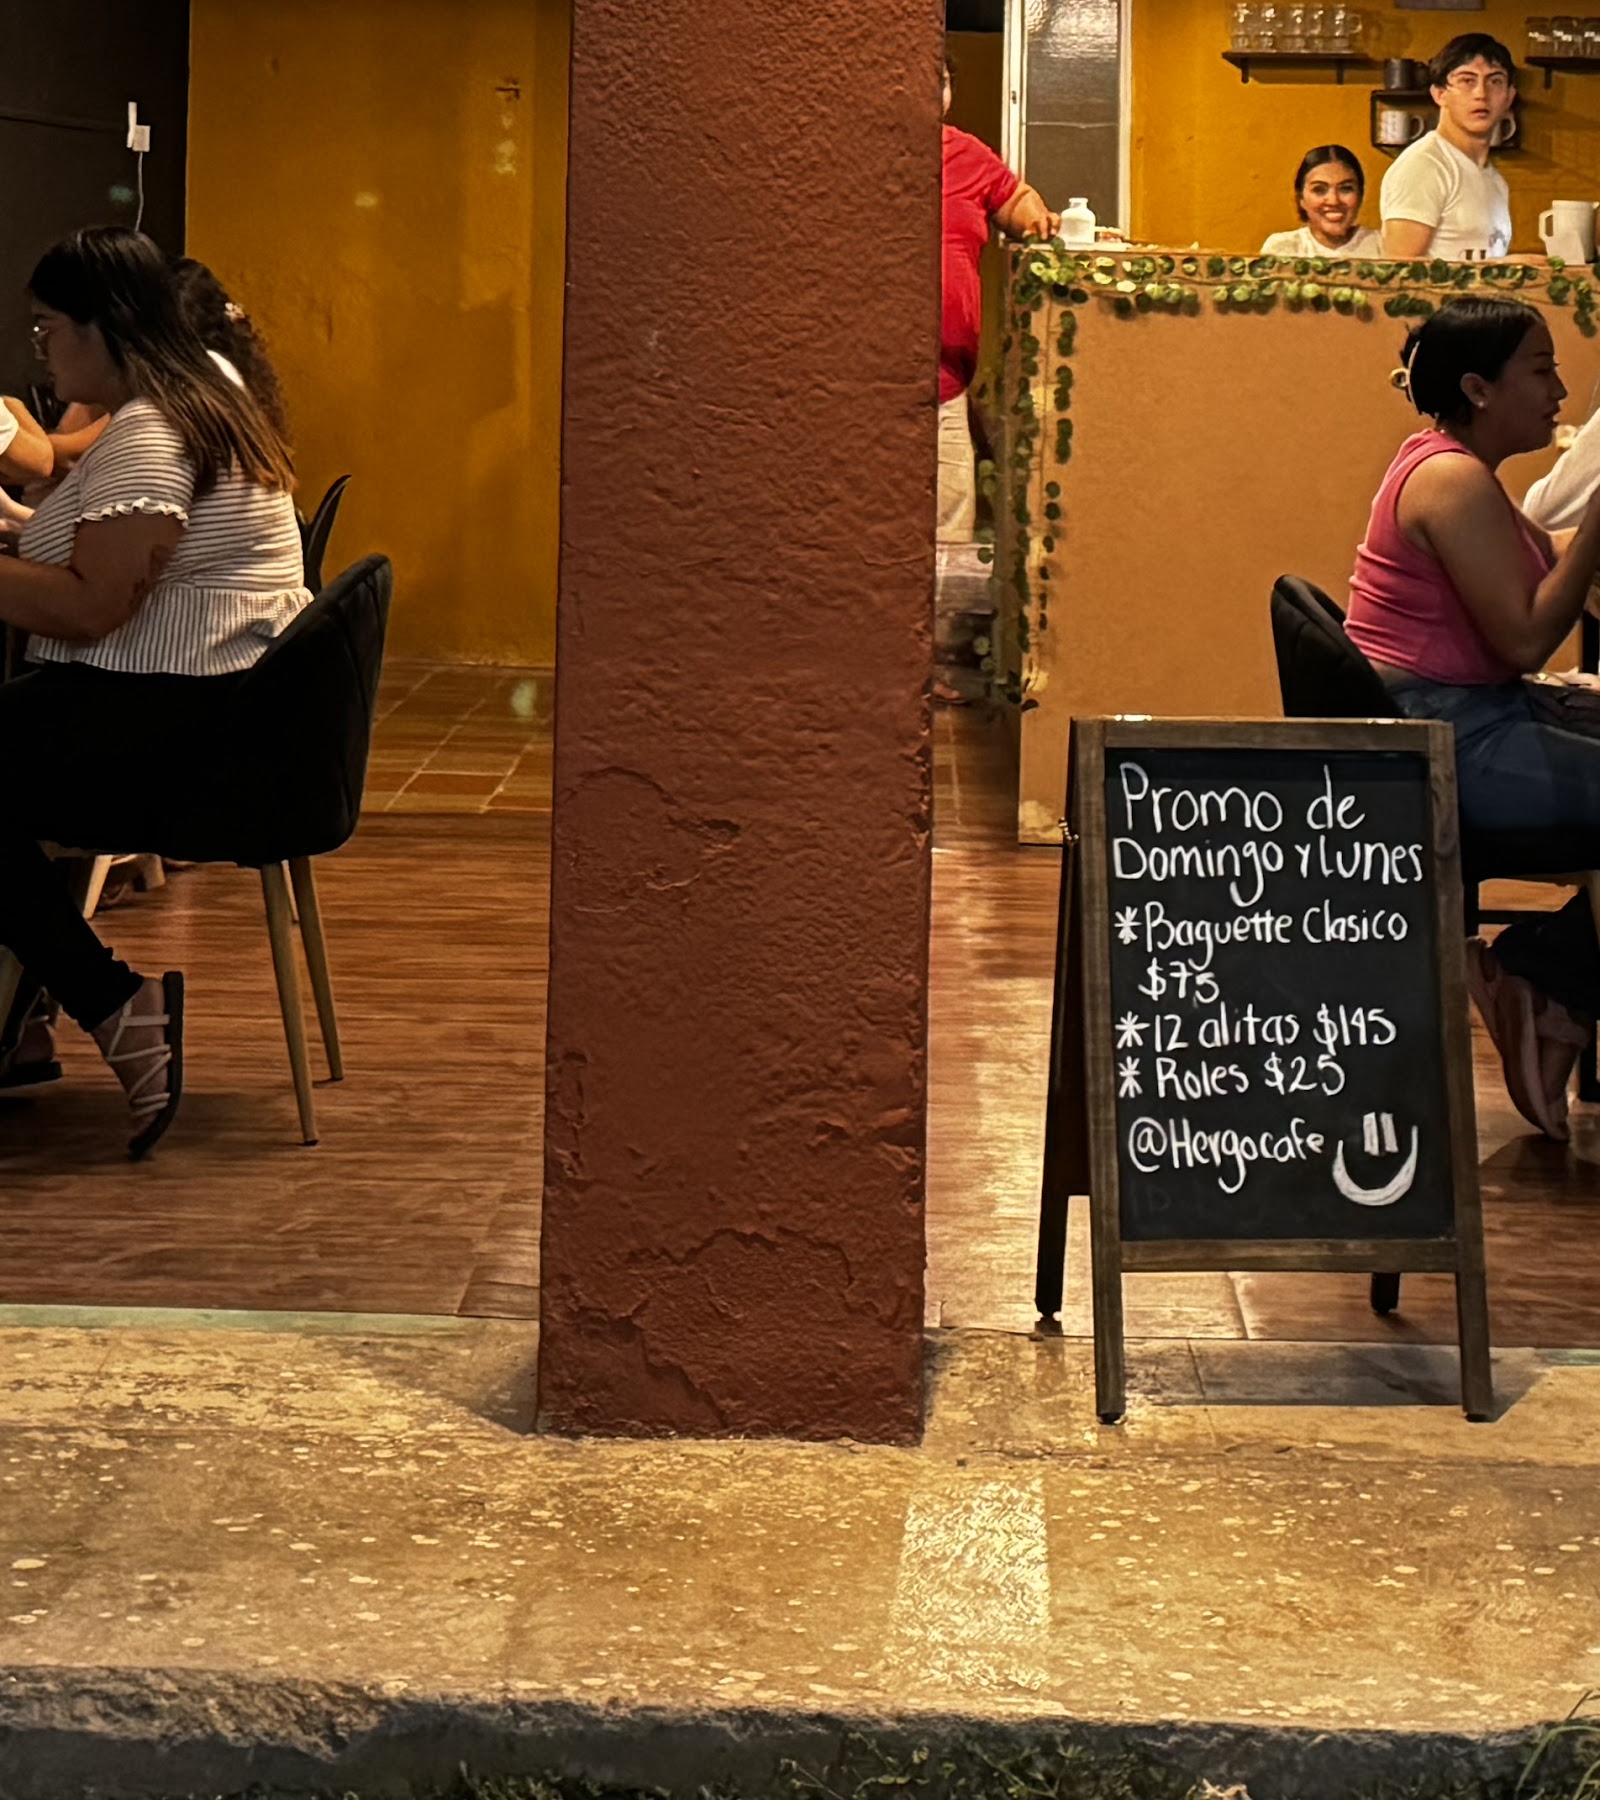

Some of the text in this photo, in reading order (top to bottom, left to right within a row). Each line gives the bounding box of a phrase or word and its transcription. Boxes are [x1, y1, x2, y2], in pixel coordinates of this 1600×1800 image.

[1120, 762, 1366, 834] Promo de
[1112, 836, 1284, 908] Domingo
[1302, 898, 1408, 944] Clasico
[1138, 956, 1220, 1004] $75
[1198, 1001, 1300, 1049] alitas
[1312, 1002, 1398, 1057] $145
[1155, 1051, 1345, 1101] Roles $25
[1127, 1116, 1325, 1194] @Hergocafe
